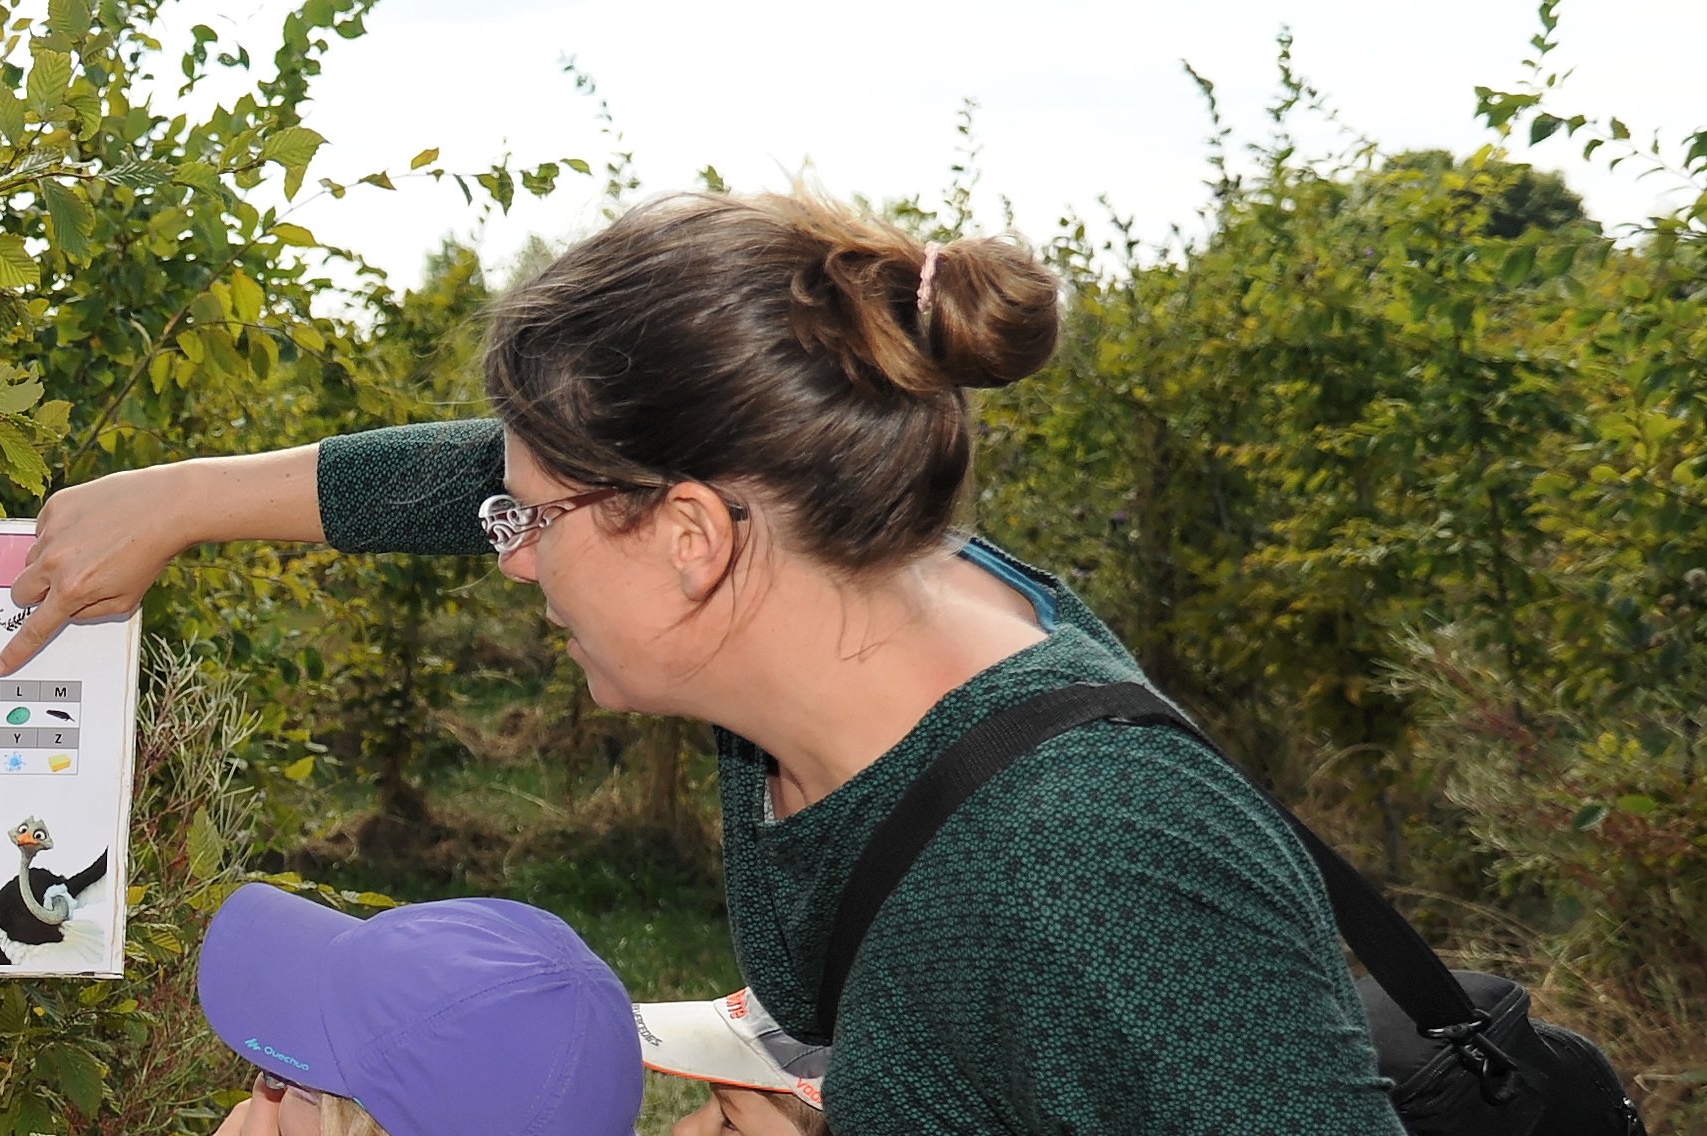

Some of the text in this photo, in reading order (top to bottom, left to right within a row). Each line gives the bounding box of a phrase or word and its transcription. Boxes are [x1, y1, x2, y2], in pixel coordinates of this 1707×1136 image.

[54, 686, 67, 698] M
[13, 733, 22, 744] Y
[54, 733, 62, 744] Z
[264, 1046, 309, 1070] Quechua
